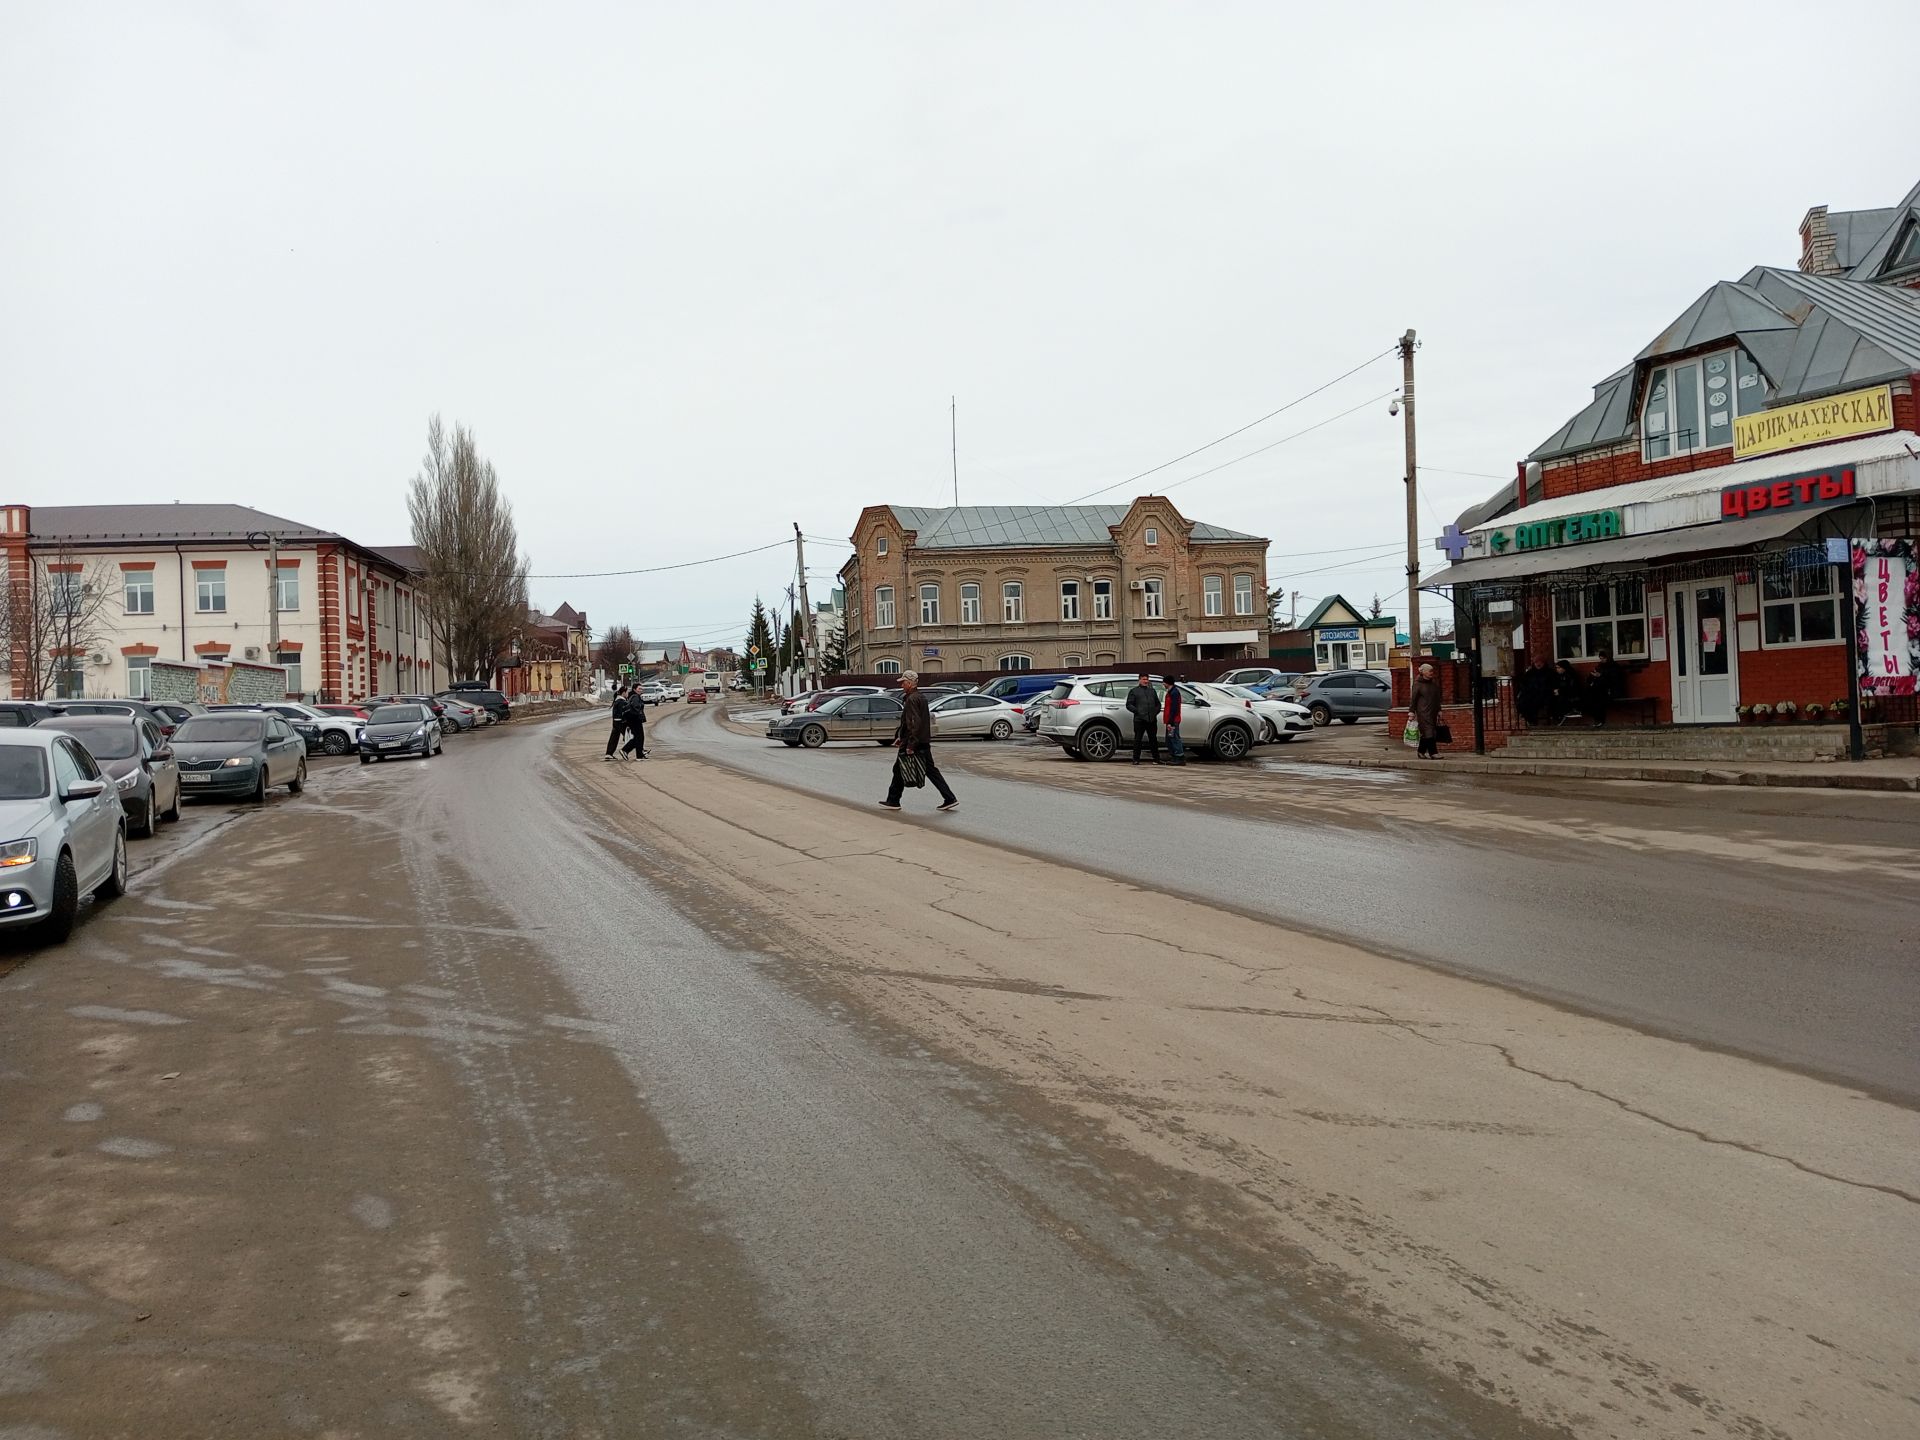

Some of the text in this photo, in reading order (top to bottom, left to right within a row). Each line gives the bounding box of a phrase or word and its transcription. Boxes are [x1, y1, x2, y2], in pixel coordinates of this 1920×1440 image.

[1736, 393, 1888, 450] ПАРИКМАХЕРСКАЯ
[1721, 470, 1855, 518] ЦВЕТЫ
[1515, 509, 1620, 549] АПТЕКА
[1878, 558, 1900, 675] ЦВЕТЫ
